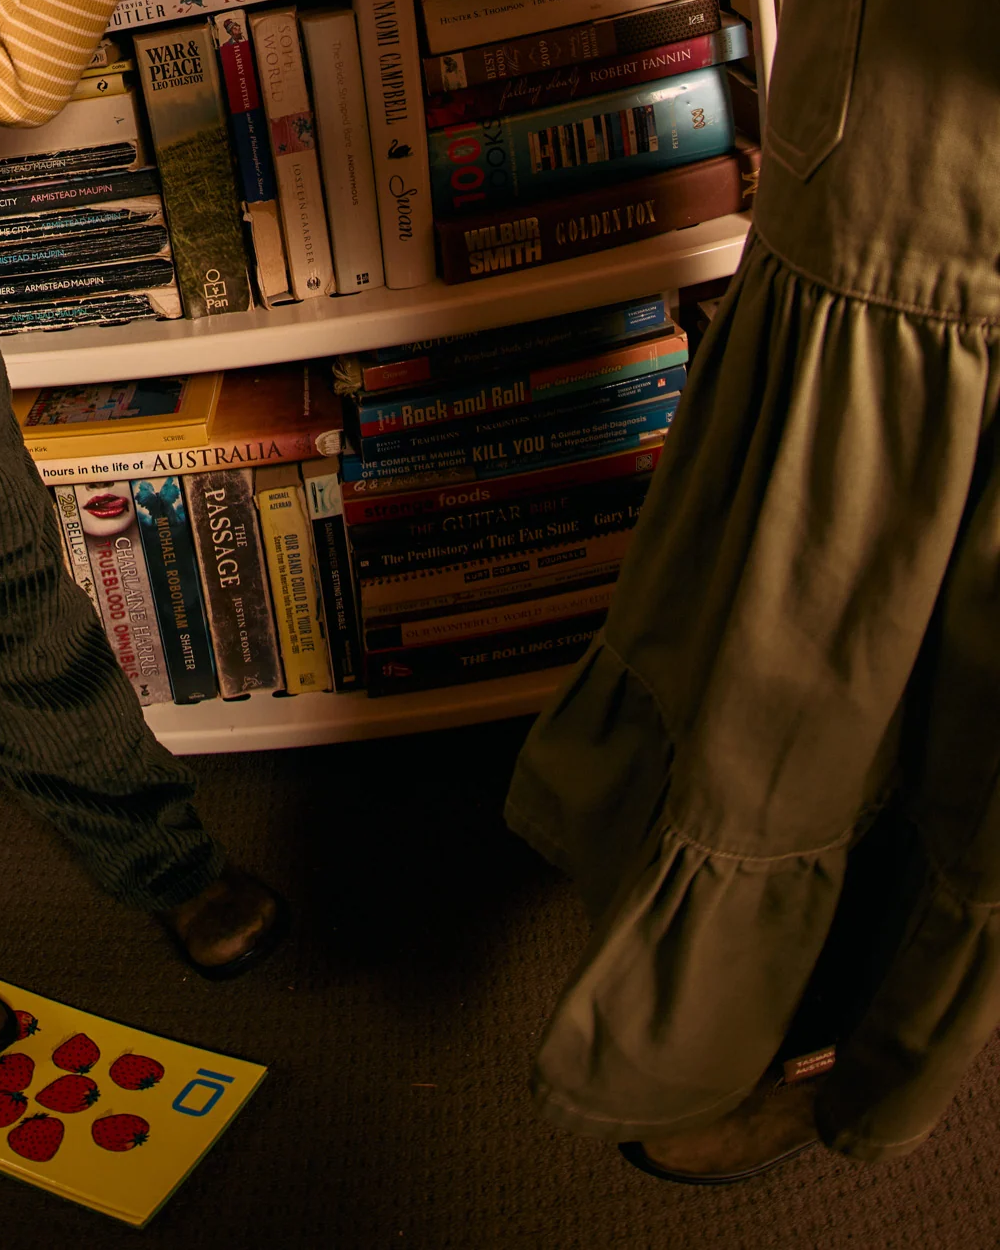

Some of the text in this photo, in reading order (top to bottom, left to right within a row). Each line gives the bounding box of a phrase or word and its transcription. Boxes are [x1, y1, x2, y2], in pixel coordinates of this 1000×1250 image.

[146, 41, 200, 64] WAR &
[373, 1, 408, 125] NAOMI CAMPBELL
[149, 57, 203, 82] PEACE
[152, 74, 204, 91] LEO TOLSTOY
[30, 184, 113, 203] ARMISTEAD MAUPIN
[389, 175, 417, 242] Swan
[464, 217, 540, 249] WILBUR
[469, 242, 542, 274] SMITH
[402, 381, 526, 427] Rock and Roll
[153, 441, 283, 472] AUSTRALIA
[472, 435, 545, 463] KILL YOU
[43, 460, 144, 477] hours in the life of
[205, 488, 241, 589] PASSAGE
[234, 523, 247, 548] THE
[157, 517, 196, 671] MICHAEL ROBOTHAM SHATTER
